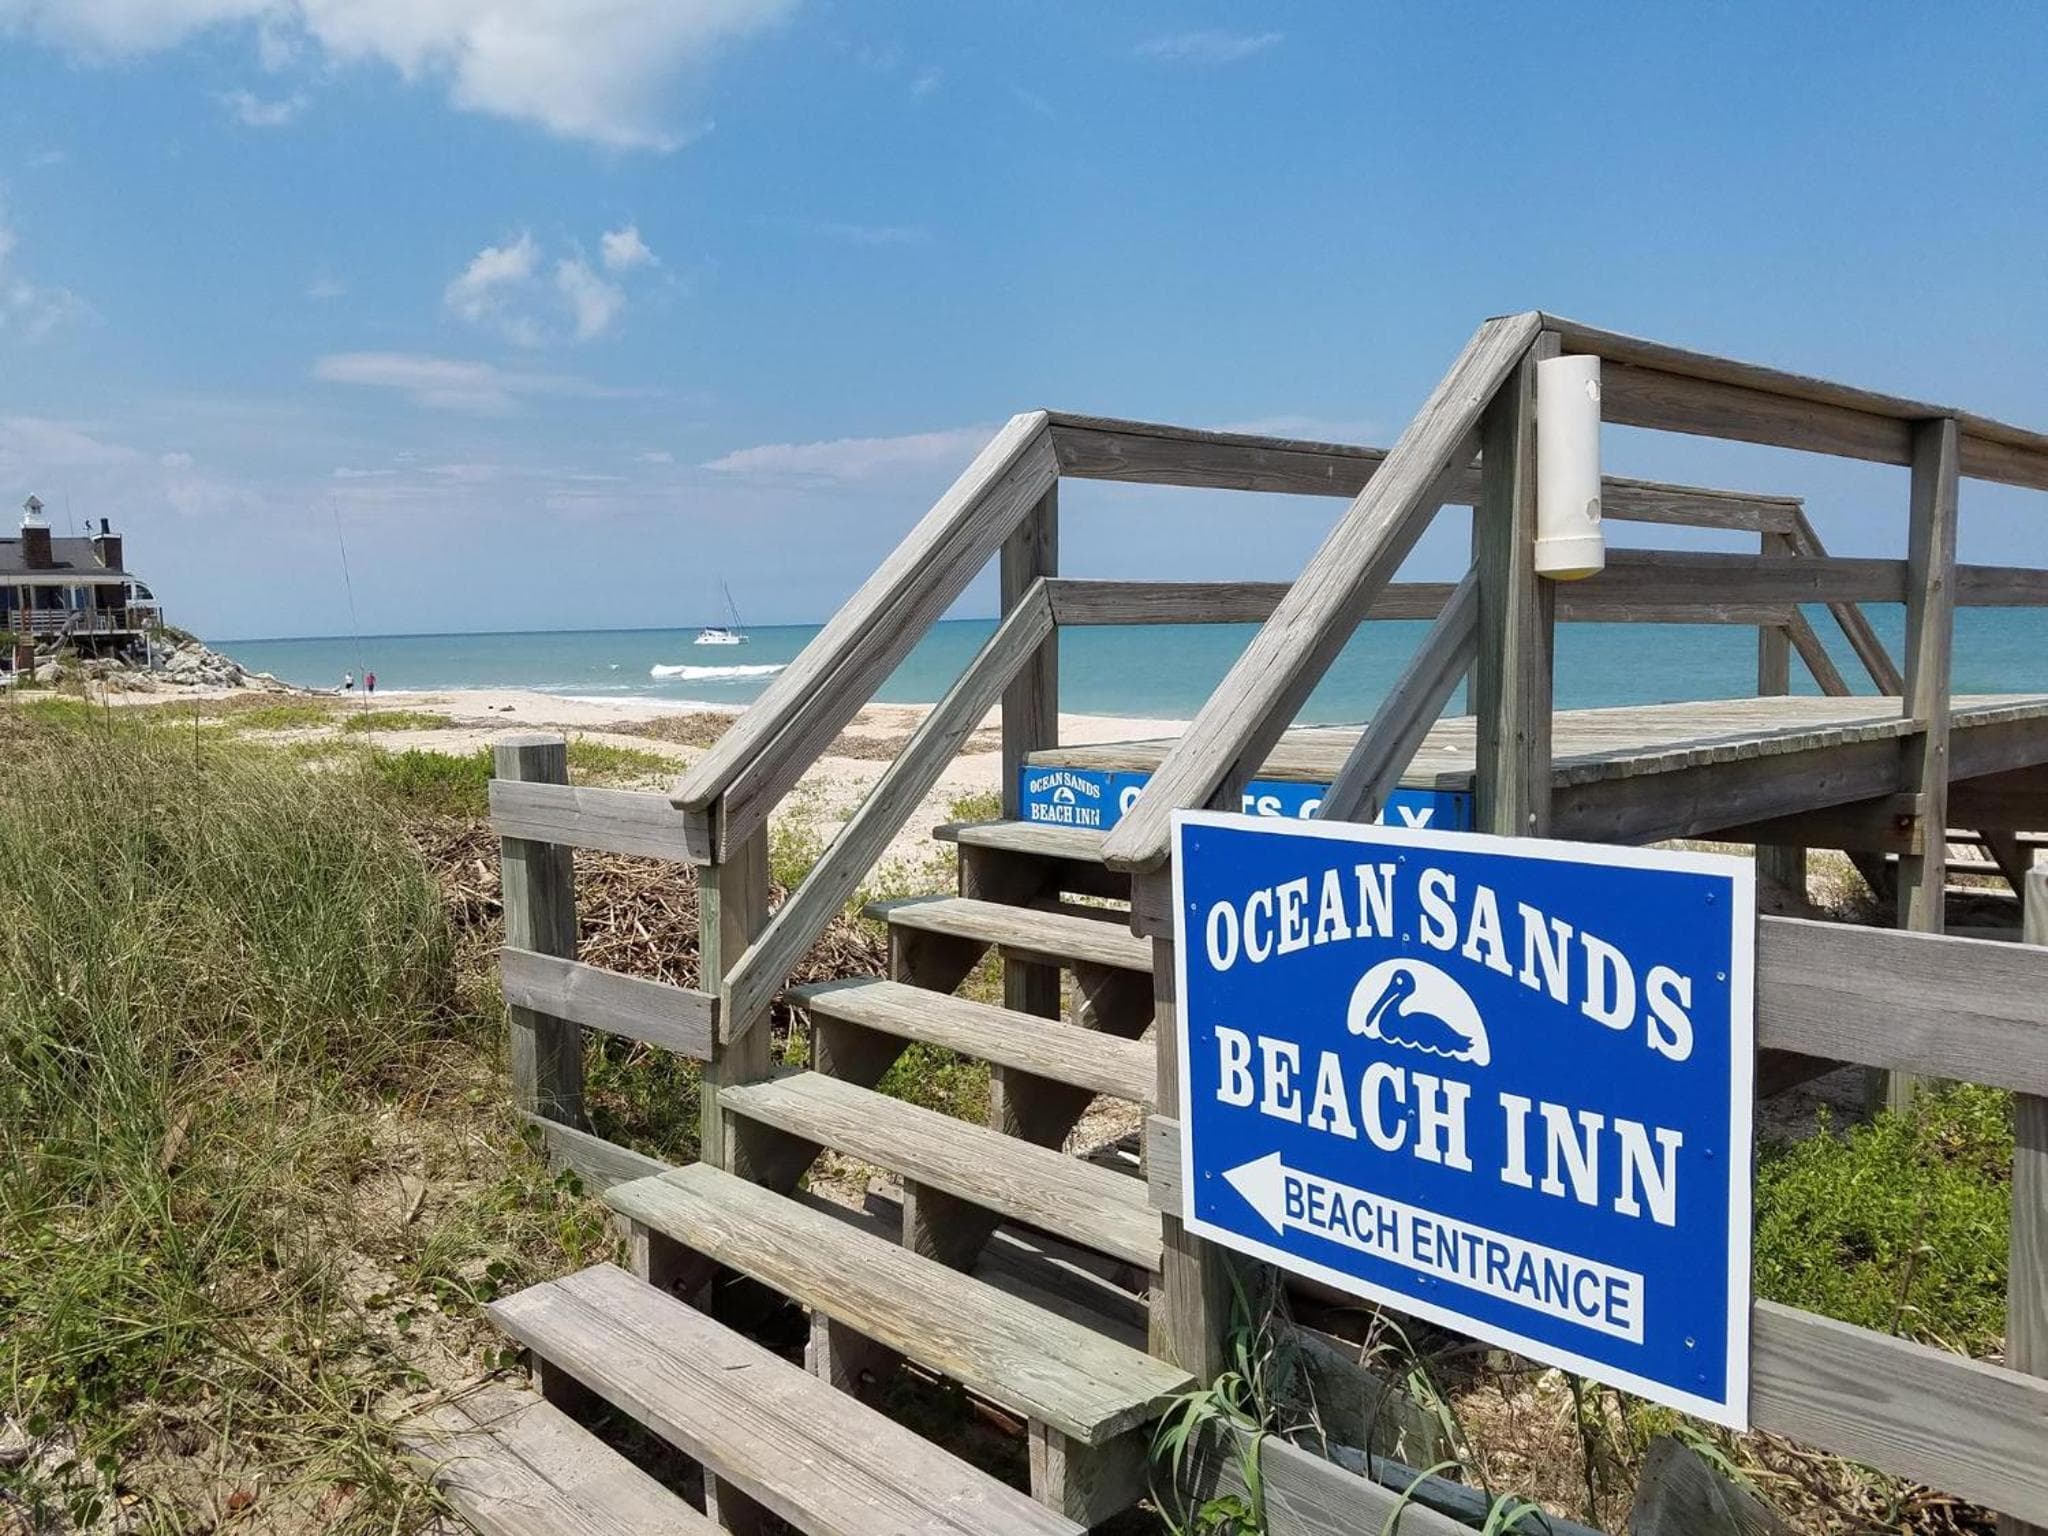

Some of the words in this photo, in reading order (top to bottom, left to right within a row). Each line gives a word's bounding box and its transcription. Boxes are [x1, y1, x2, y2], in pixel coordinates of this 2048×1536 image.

[1030, 772, 1063, 794] OCEAN
[1064, 772, 1100, 798] SANDS
[1031, 803, 1073, 822] BEACH
[1075, 807, 1100, 825] INN
[1206, 863, 1396, 972] OCEAN
[1418, 867, 1694, 1062] SANDS
[1215, 1025, 1473, 1173] BEACH
[1499, 1091, 1683, 1228] INN
[1284, 1176, 1399, 1253] BEACH
[1412, 1215, 1630, 1330] ENTRANCE
